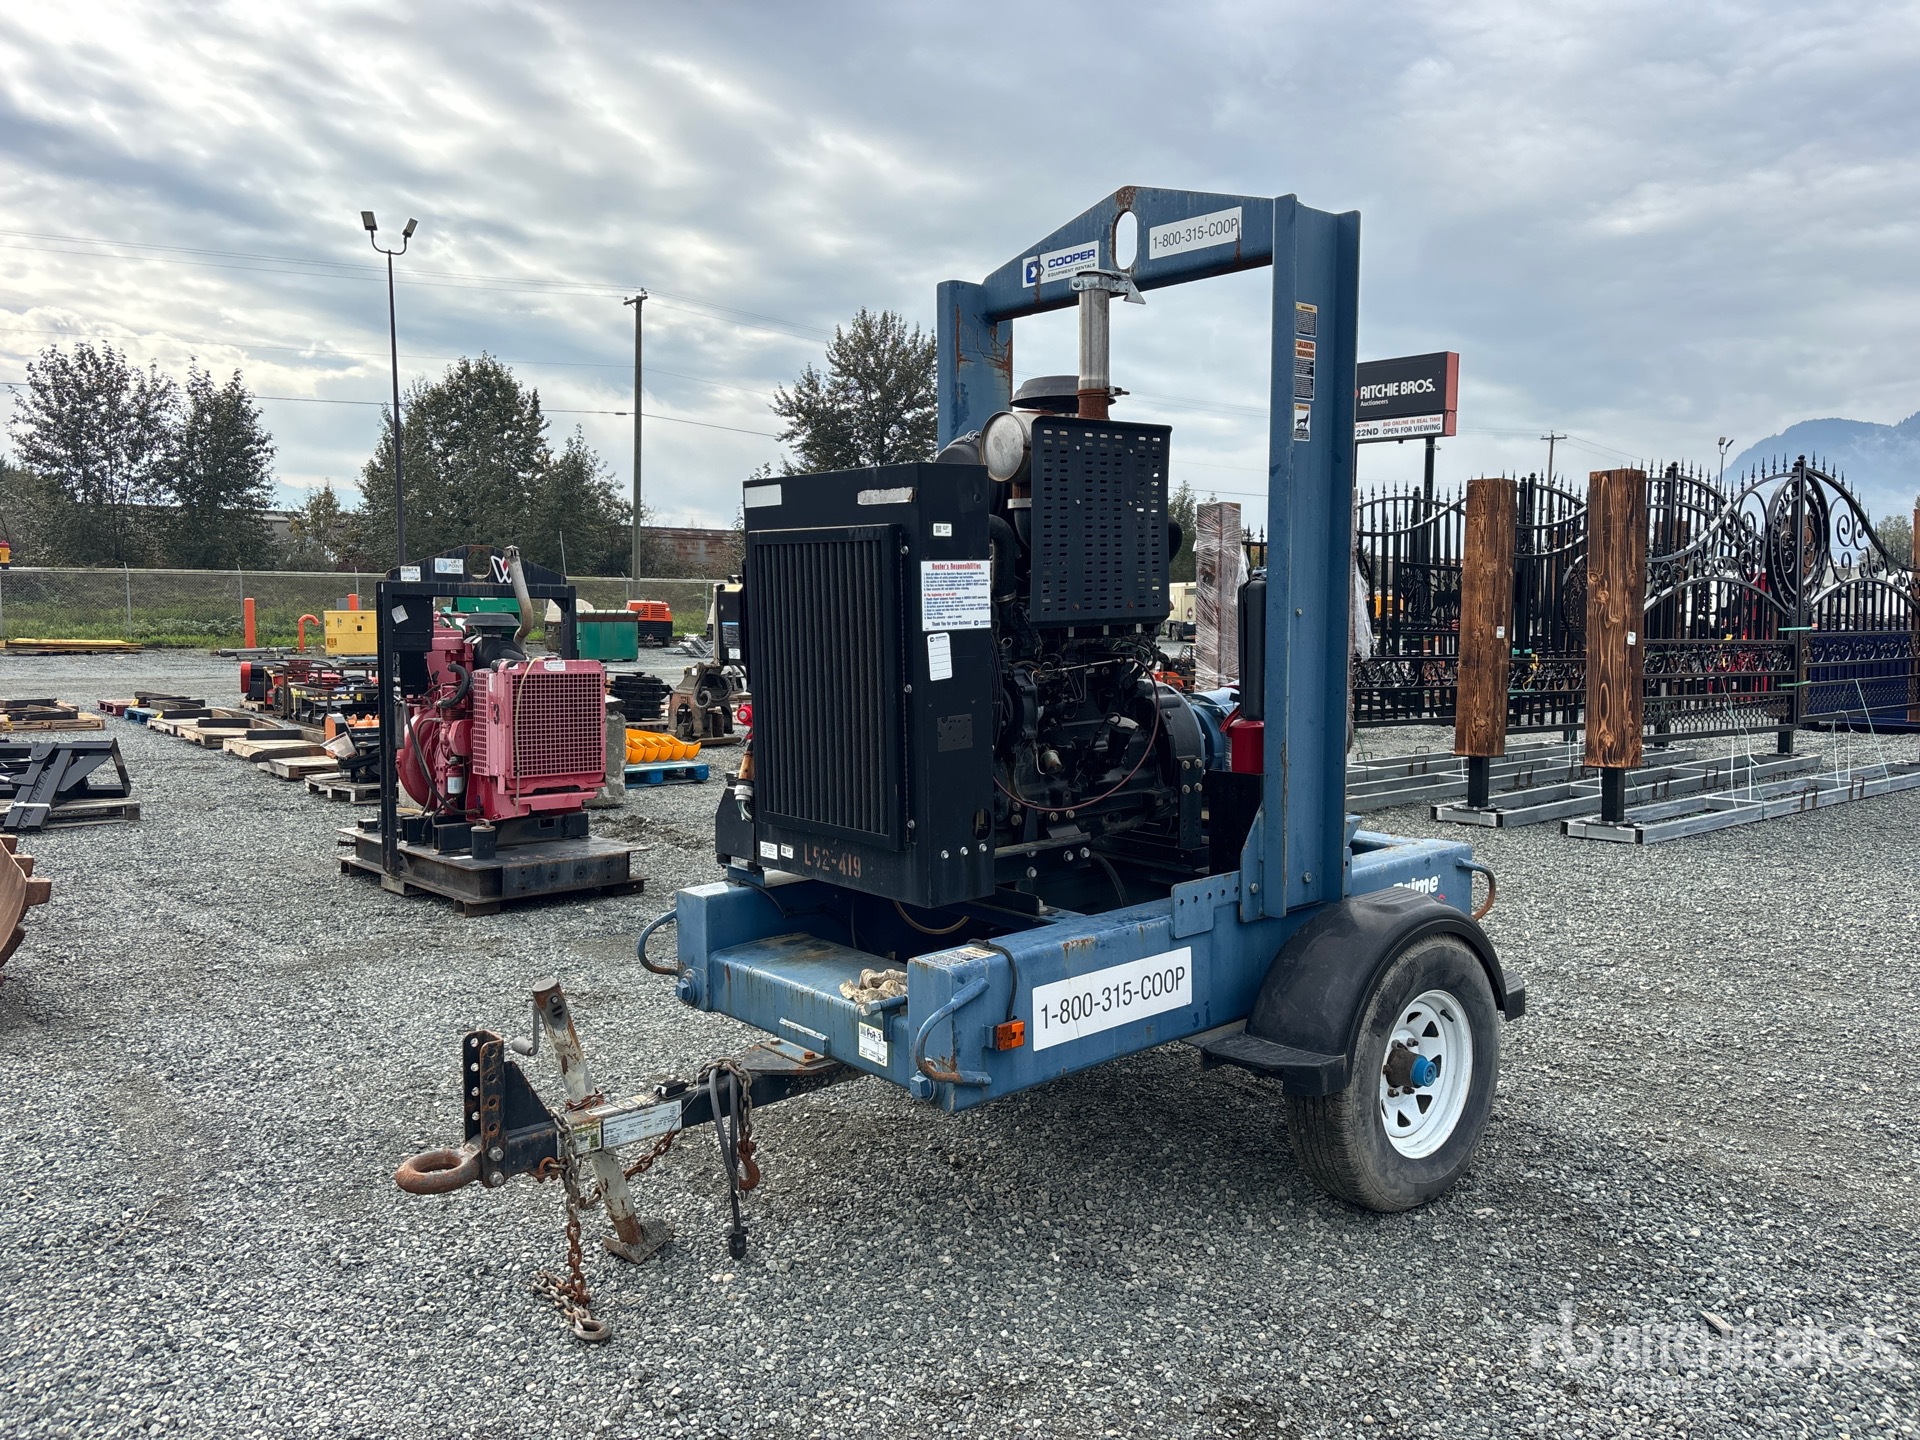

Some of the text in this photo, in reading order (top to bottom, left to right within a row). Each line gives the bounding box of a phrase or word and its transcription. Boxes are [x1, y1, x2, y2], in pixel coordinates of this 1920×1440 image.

[1153, 218, 1238, 249] 1-800-315-COOP
[1048, 249, 1096, 269] COOPER
[1048, 263, 1096, 278] EQUIPMENT RENTALS
[1360, 378, 1436, 400] RITCHIE BROS.
[1360, 399, 1389, 407] Auctioneers
[1356, 428, 1379, 437] 22ND
[1383, 427, 1399, 435] OPEN
[1413, 423, 1441, 432] VIEWING
[1041, 966, 1185, 1029] 1-800-315-COOP
